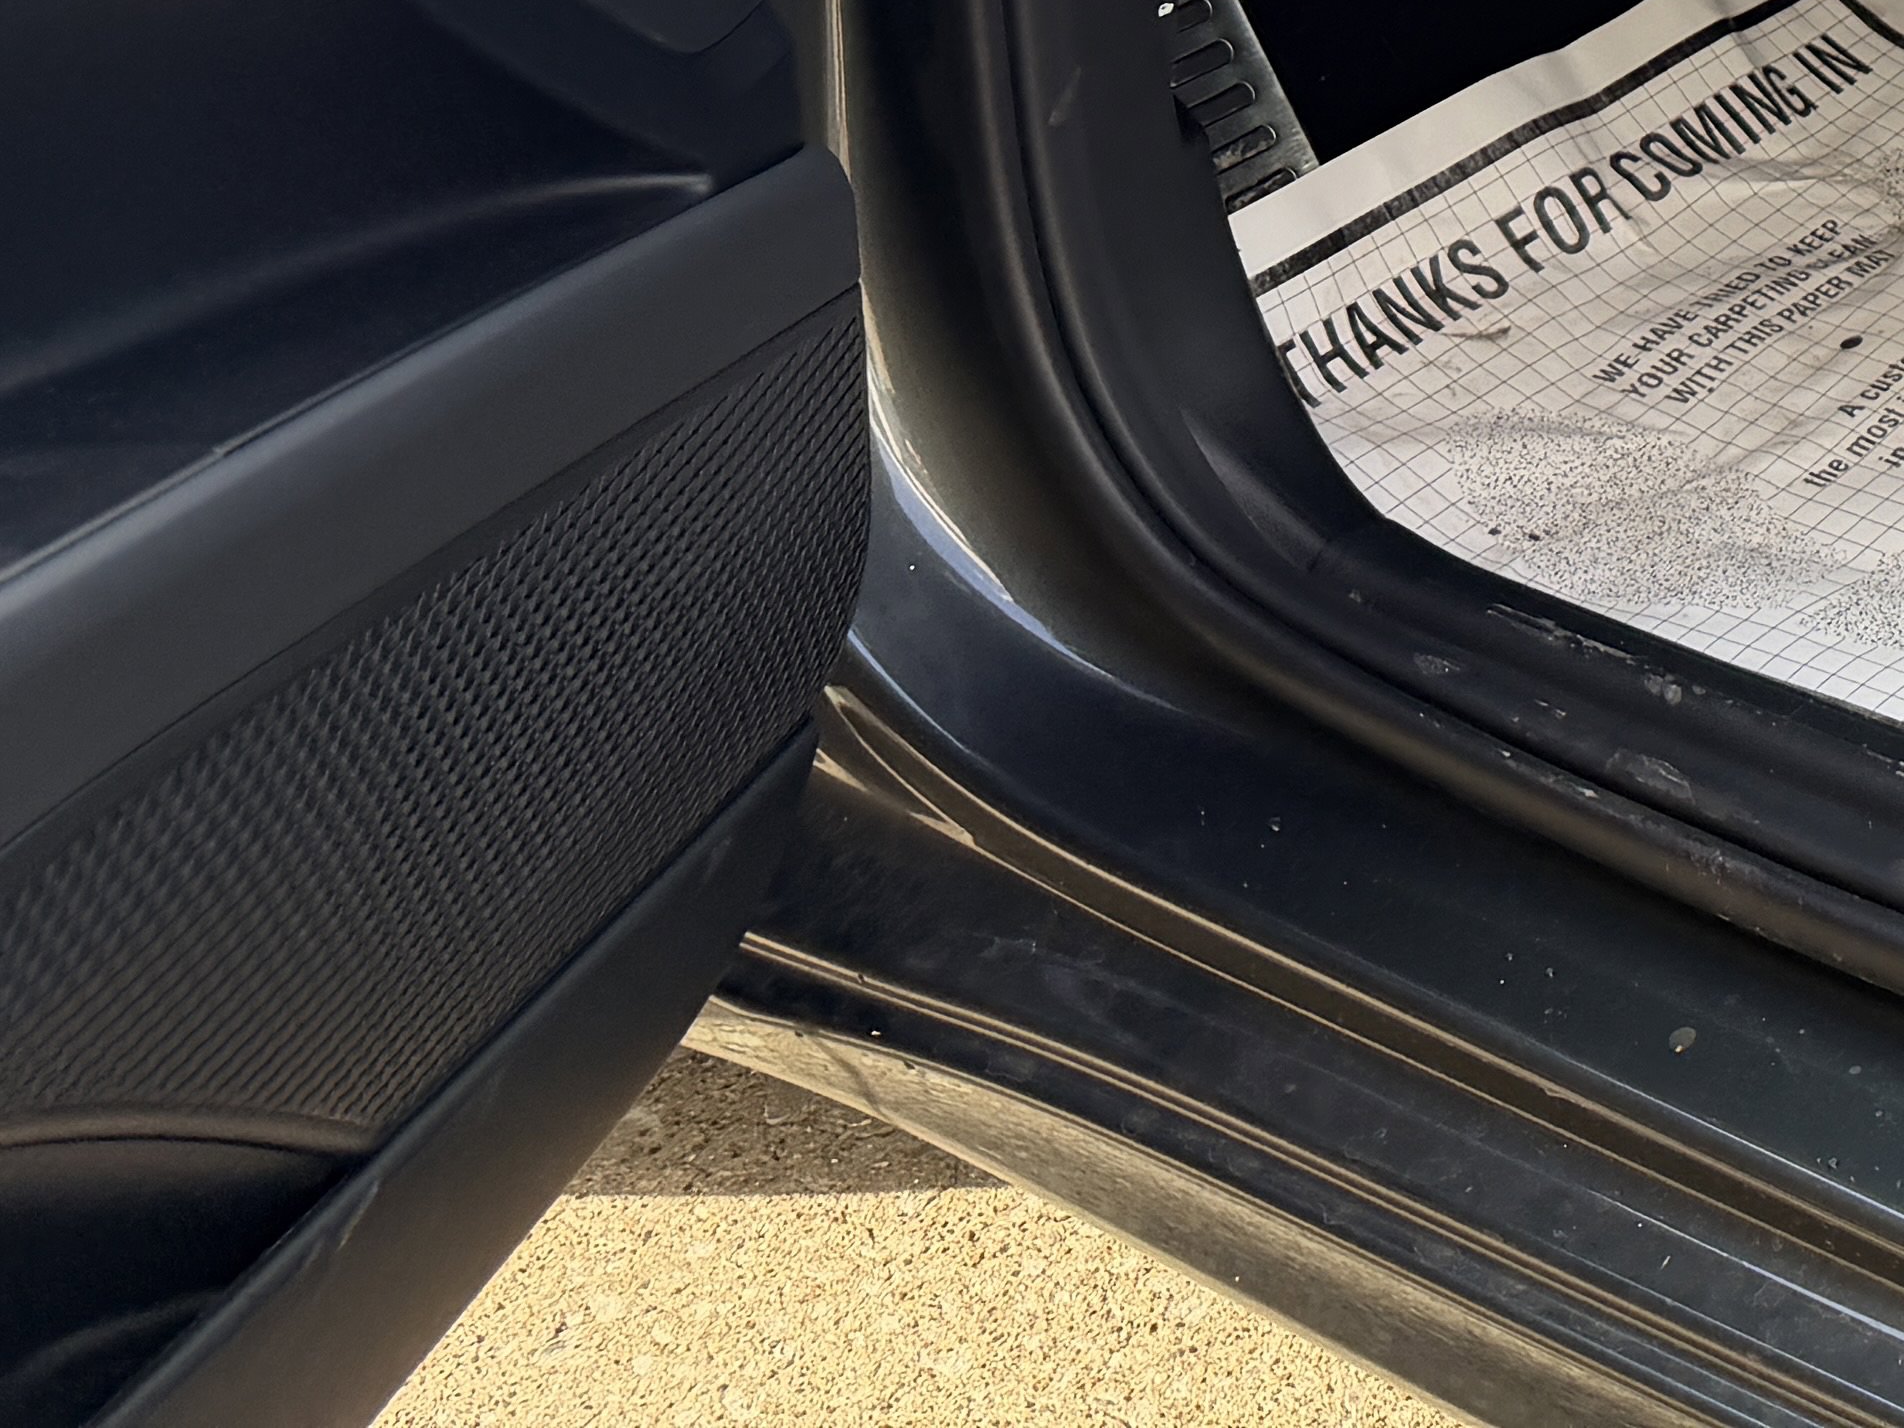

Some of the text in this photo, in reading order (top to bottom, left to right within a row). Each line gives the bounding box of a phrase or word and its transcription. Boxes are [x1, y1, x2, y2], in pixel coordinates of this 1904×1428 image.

[1278, 33, 1874, 408] THANKS FOR COMING IN
[1591, 352, 1642, 384] WE
[1631, 308, 1699, 354] HAVE
[1755, 255, 1792, 276] TO
[1787, 218, 1843, 257] KEEP
[1620, 347, 1697, 399] YOUR
[1687, 269, 1813, 349] CARPETING
[1664, 248, 1896, 405] WITH THIS PAPER MAT
[1803, 458, 1850, 488] the
[1837, 403, 1866, 419] A
